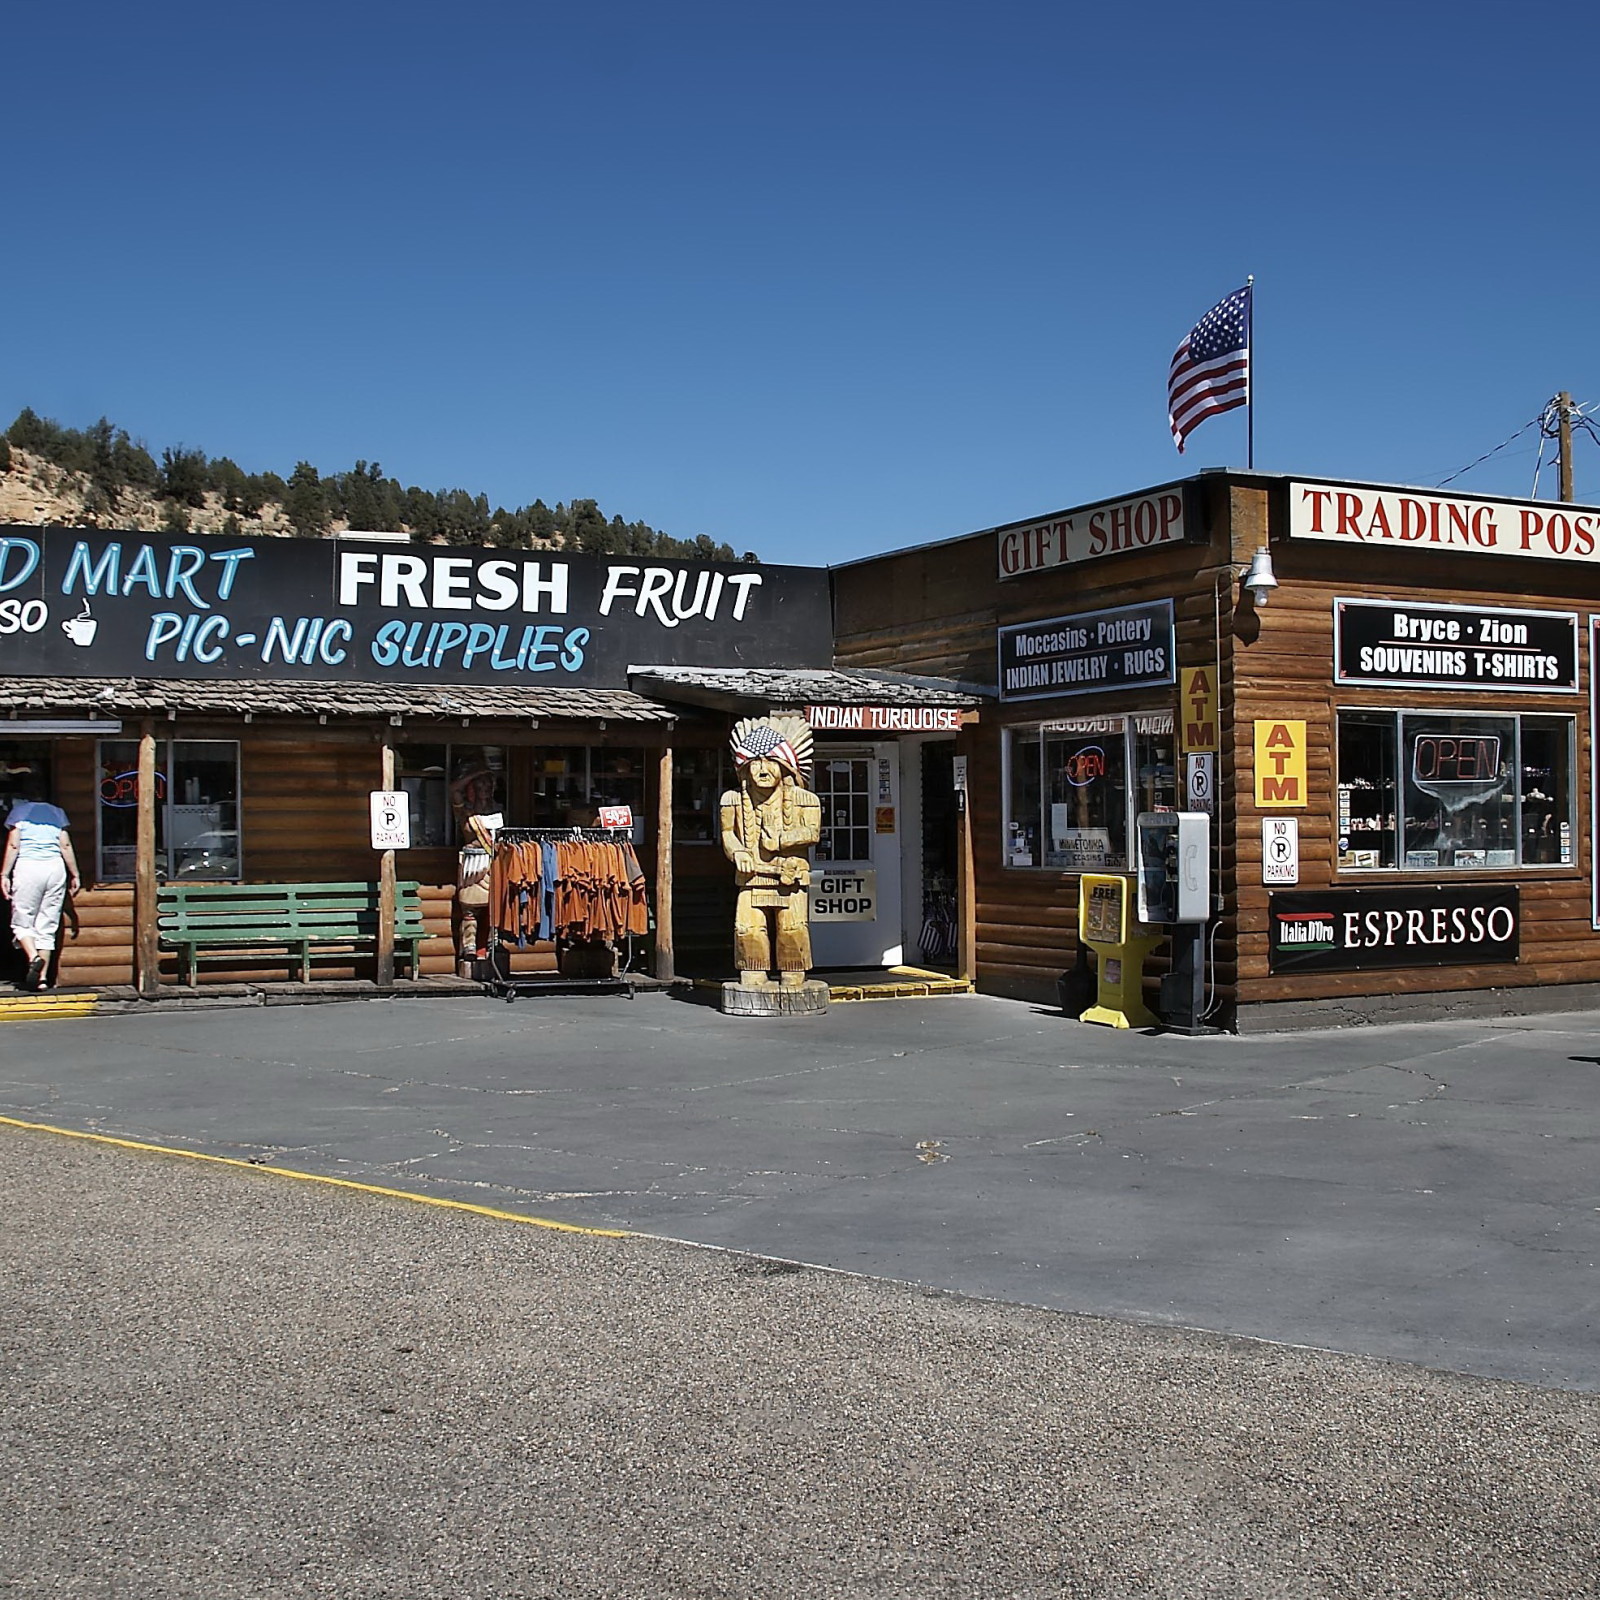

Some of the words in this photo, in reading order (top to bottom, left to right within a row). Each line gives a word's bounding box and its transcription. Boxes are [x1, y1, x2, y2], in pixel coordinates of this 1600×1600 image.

[1000, 519, 1074, 575] GIFT
[1088, 494, 1182, 556] SHOP
[1302, 488, 1498, 547] TRADING
[1518, 509, 1600, 556] POS
[61, 541, 255, 609] MART
[338, 551, 569, 614] FRESH
[598, 565, 763, 629] FRUIT
[0, 599, 48, 634] SO
[1393, 613, 1461, 642] Bryce
[1479, 618, 1528, 645] Zion
[145, 611, 354, 665] PIC-NIC
[371, 620, 591, 673] SUPPLIES
[1016, 627, 1087, 657] Moccasins
[1097, 617, 1152, 645] Pottery
[1006, 663, 1049, 690] INDIAN
[1051, 655, 1108, 685] JEWELRY
[1124, 647, 1166, 676] RUGS
[1360, 646, 1467, 676] SOUVENIRS
[810, 705, 864, 729] INDIAN
[869, 707, 959, 730] TURQUOISE
[1187, 670, 1214, 747] ATM
[1067, 754, 1105, 778] OPEN
[1195, 756, 1205, 769] NO
[1262, 724, 1299, 801] ATM
[1417, 739, 1497, 779] OPEN
[383, 795, 396, 807] NO
[376, 832, 405, 844] PARKING
[1274, 822, 1287, 835] NO
[820, 878, 865, 894] GIFT
[1267, 864, 1295, 878] PARKING
[814, 898, 872, 914] SHOP
[1092, 886, 1117, 900] FREE
[1343, 906, 1514, 948] ESPRESSO
